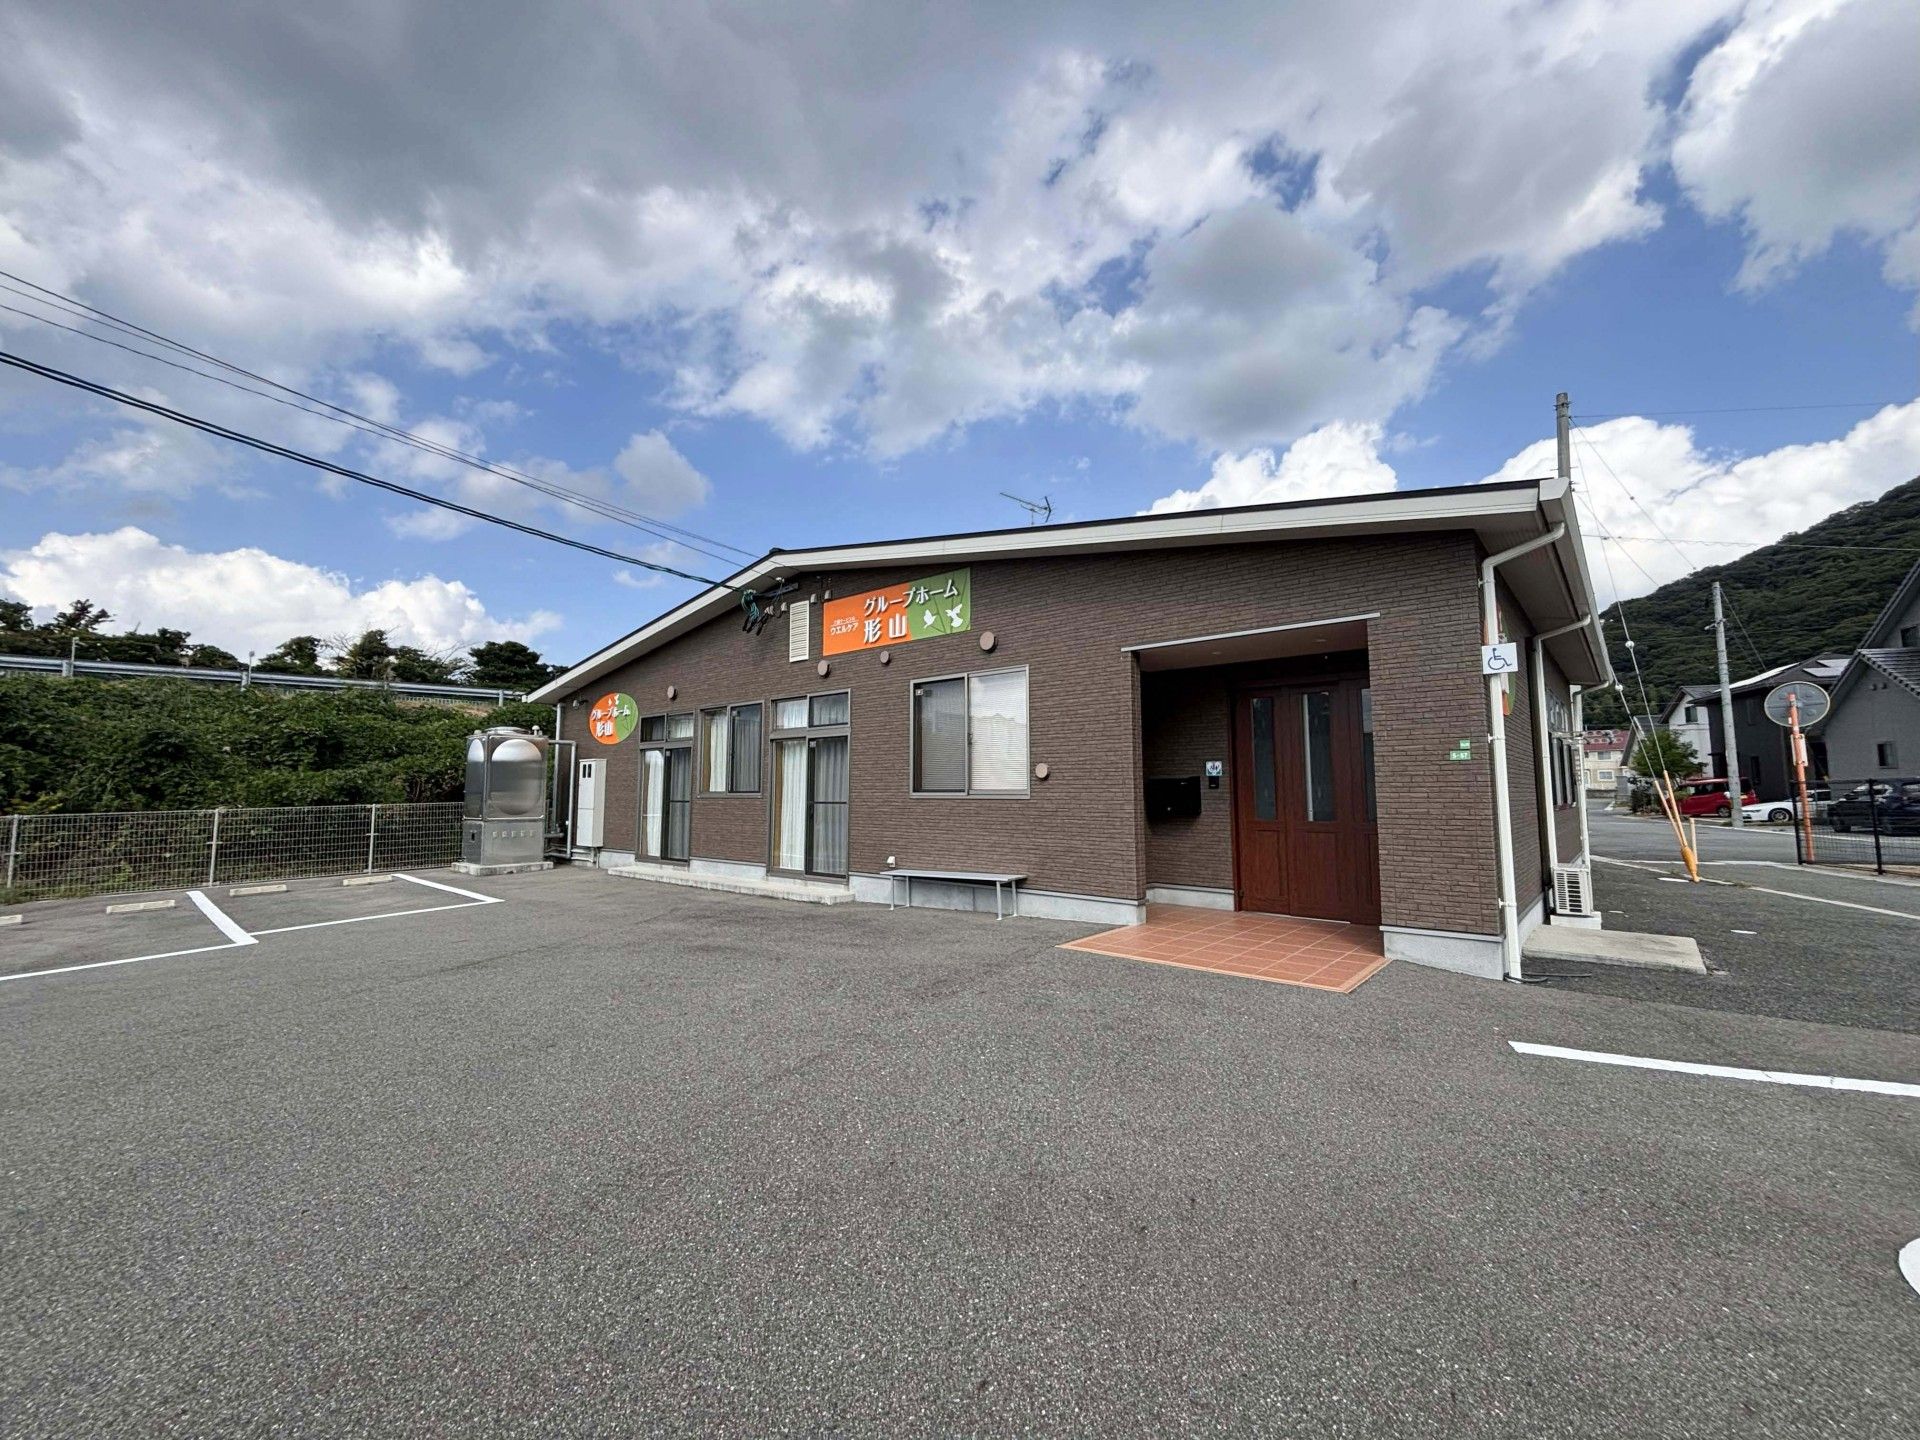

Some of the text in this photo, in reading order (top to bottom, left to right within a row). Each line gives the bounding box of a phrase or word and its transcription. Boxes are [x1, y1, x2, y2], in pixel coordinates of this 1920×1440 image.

[864, 579, 959, 616] グループホーム
[863, 613, 907, 643] 形山
